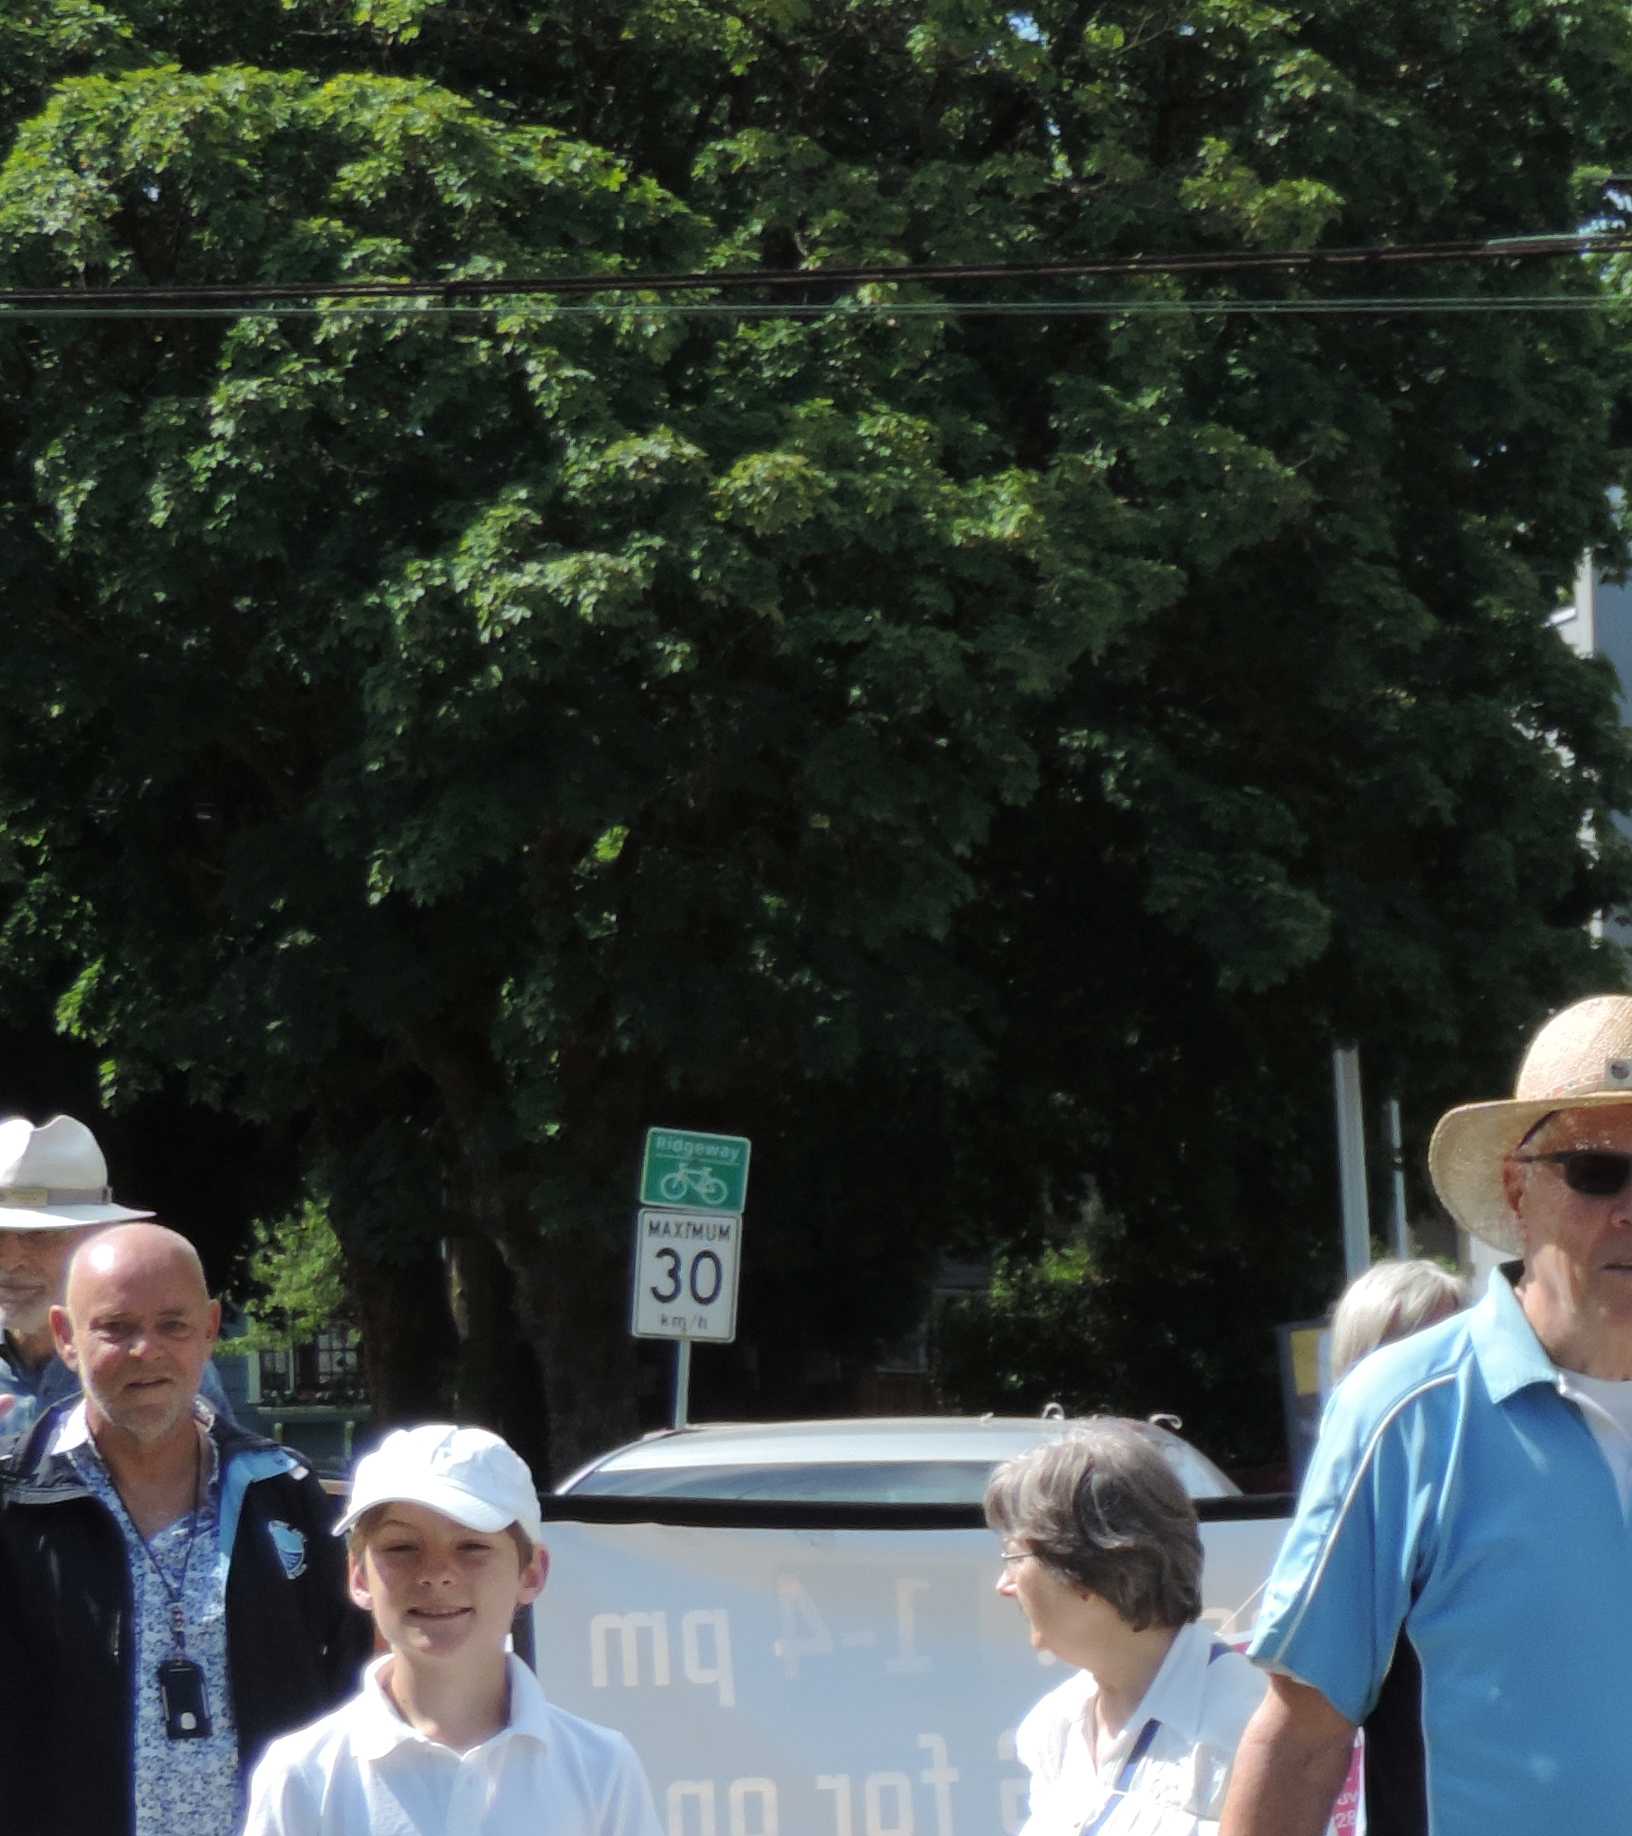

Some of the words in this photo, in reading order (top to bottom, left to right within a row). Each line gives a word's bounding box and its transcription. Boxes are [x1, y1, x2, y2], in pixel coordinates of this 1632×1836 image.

[655, 1135, 741, 1163] Ridgeway
[648, 1219, 730, 1242] MAXIMUM
[651, 1247, 722, 1306] 30
[660, 1312, 708, 1331] km/h
